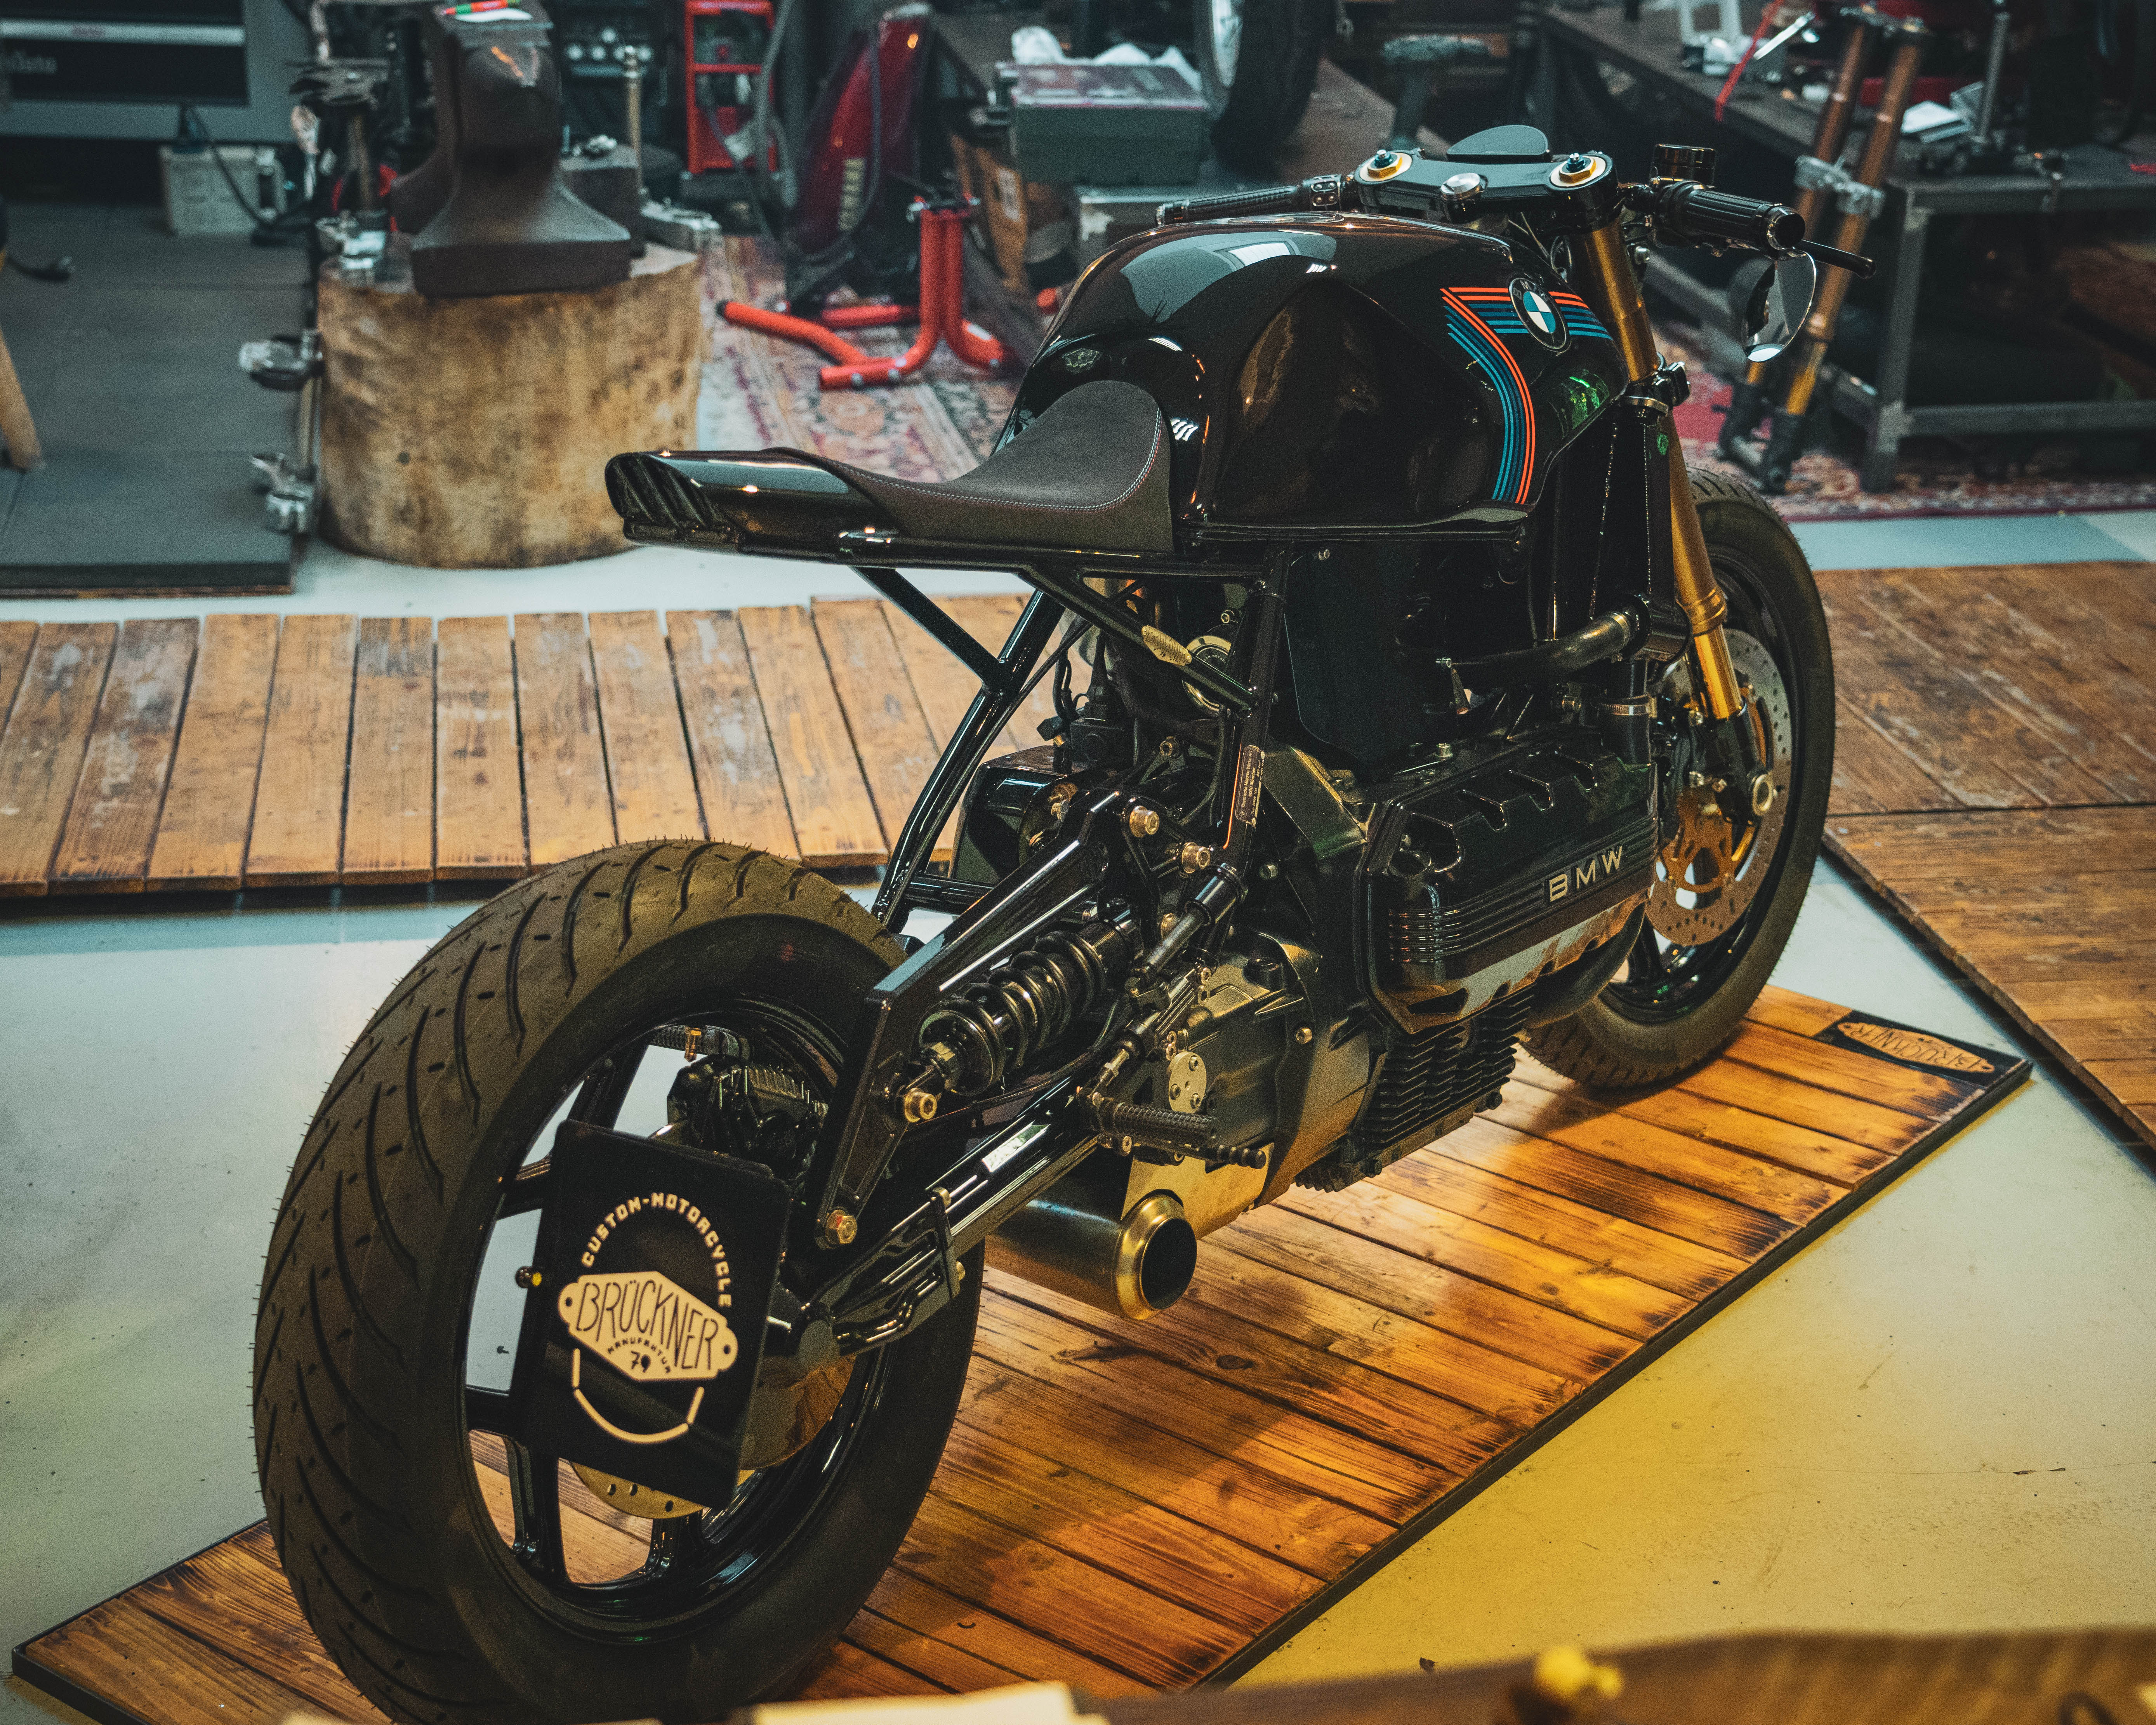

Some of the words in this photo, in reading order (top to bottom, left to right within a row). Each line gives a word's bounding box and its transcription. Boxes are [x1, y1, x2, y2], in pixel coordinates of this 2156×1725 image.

[1513, 280, 1548, 302] BMW
[1549, 846, 1623, 902] BMW
[582, 1192, 732, 1307] CUSTOM-MOTORCYCLE
[576, 1279, 719, 1370] BRÜCKNER
[607, 1337, 671, 1374] MANUFAKTUR
[630, 1350, 652, 1373] 79
